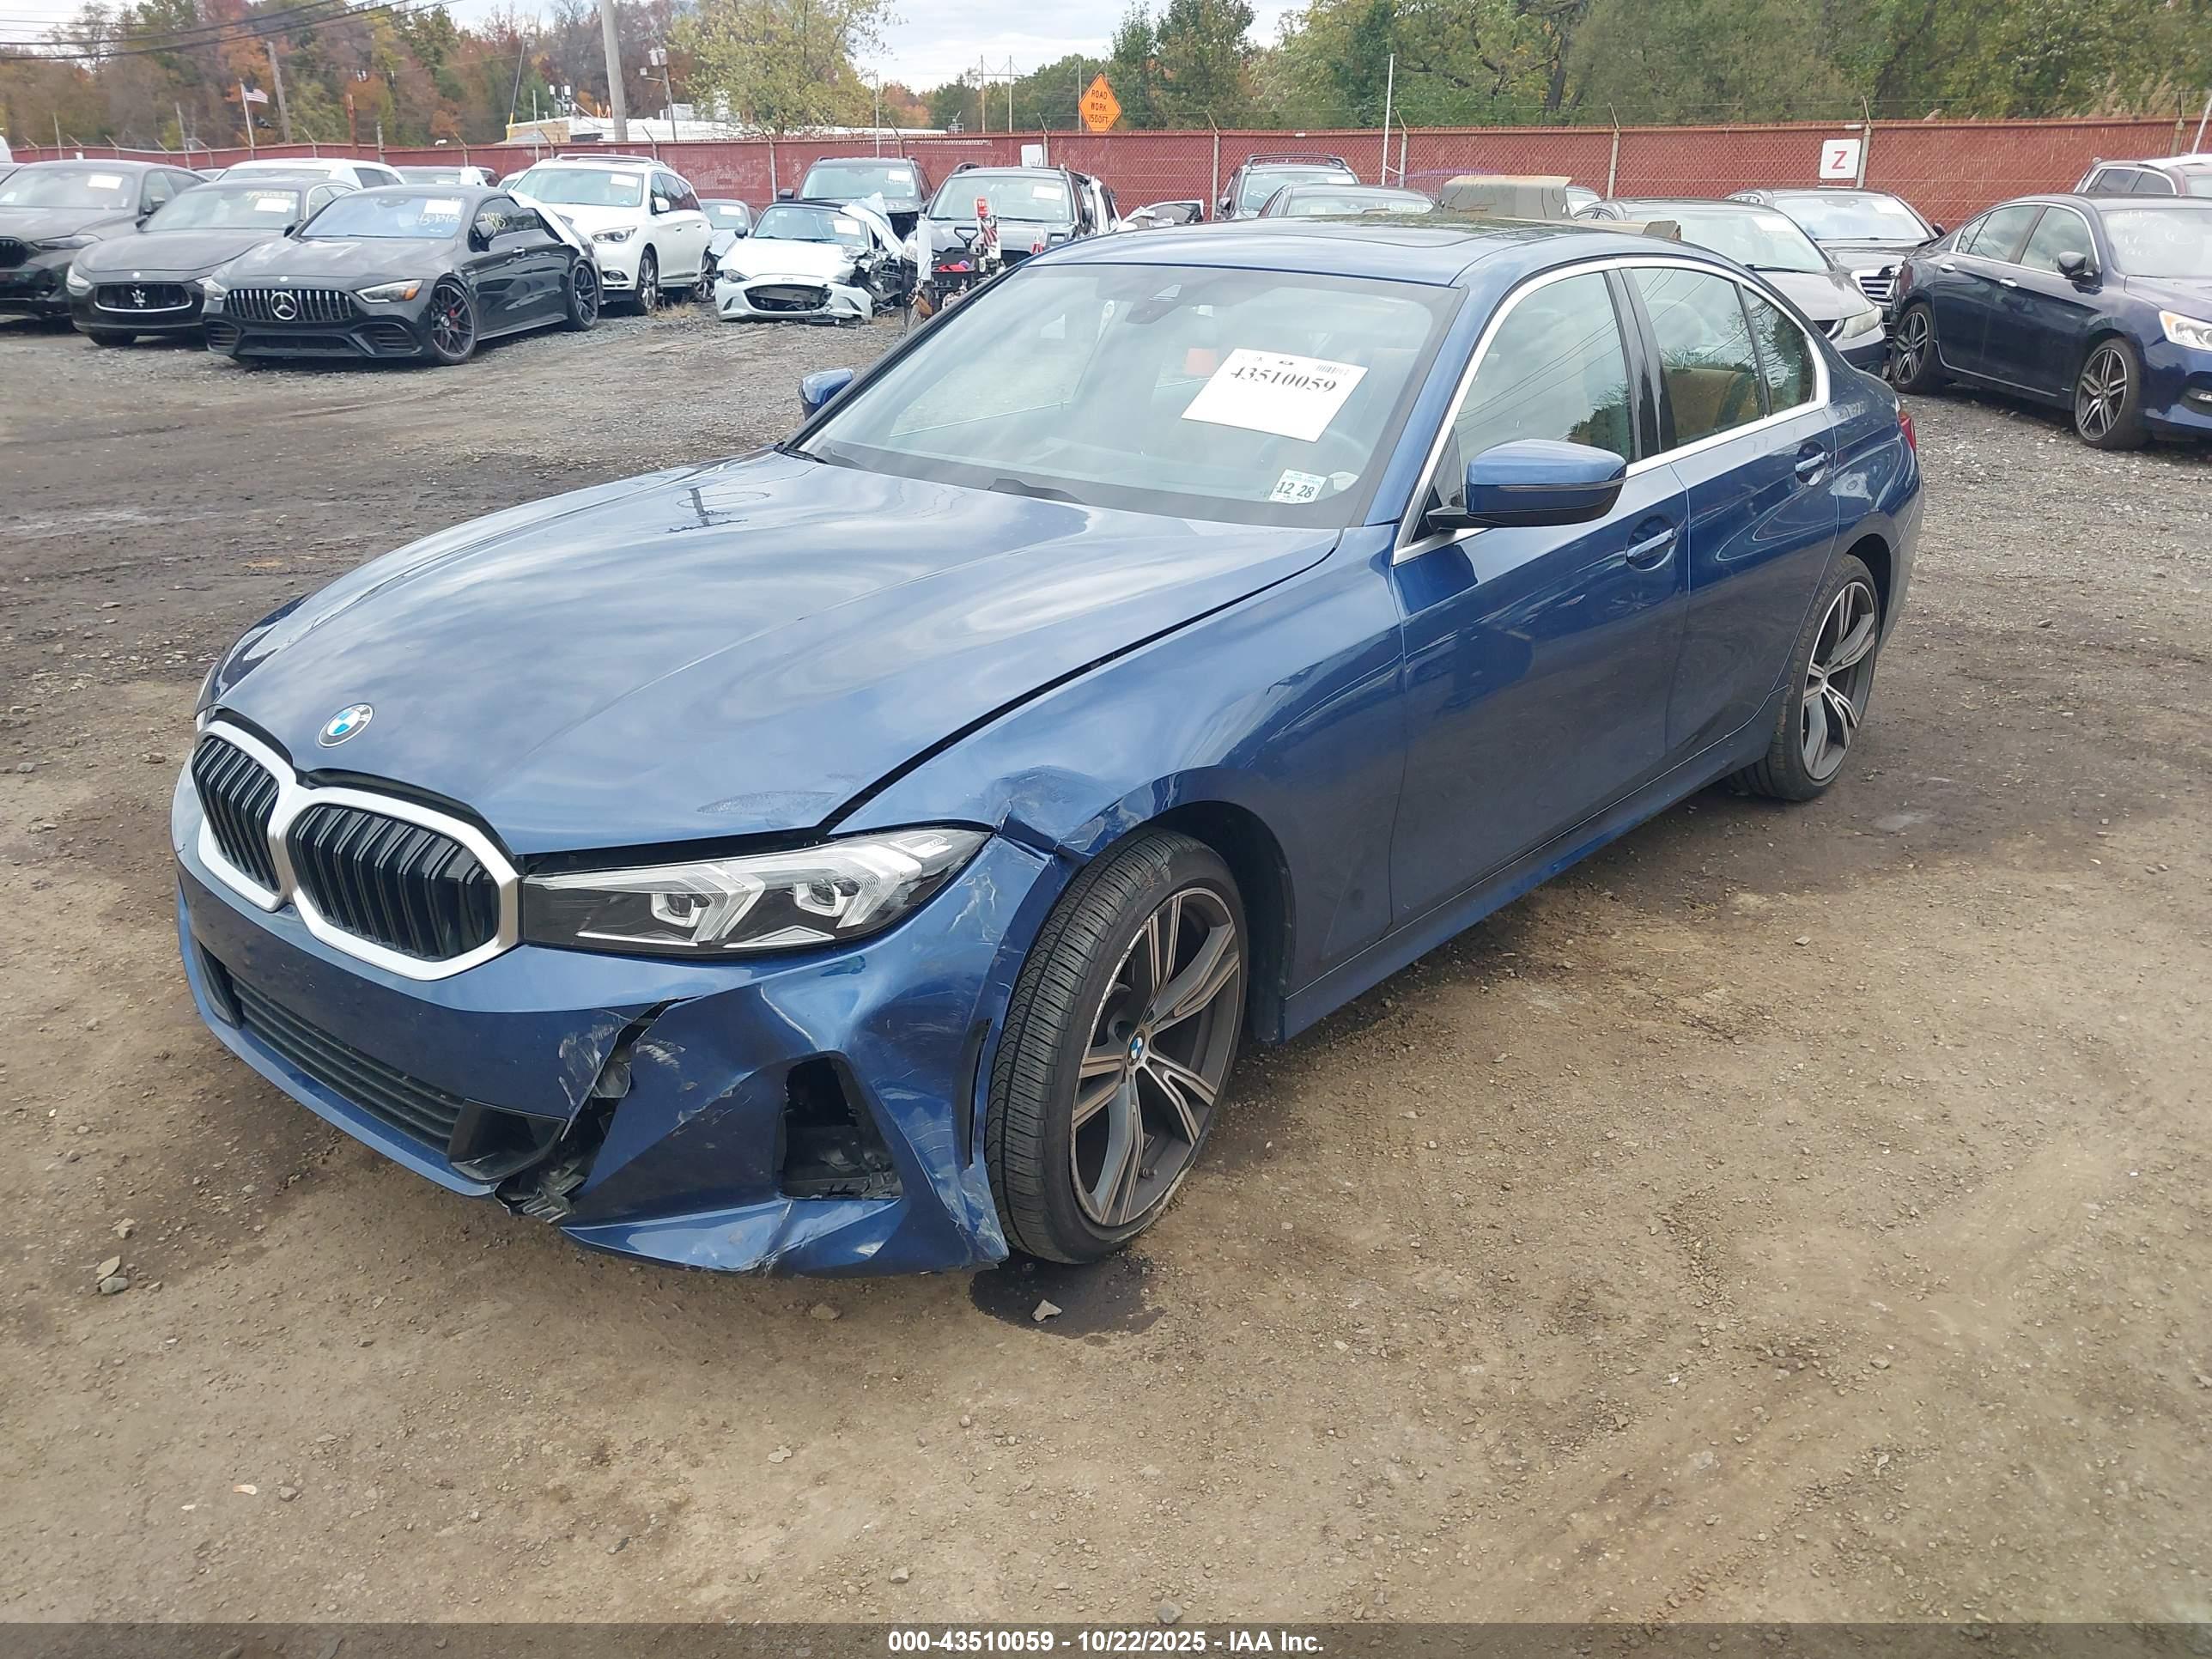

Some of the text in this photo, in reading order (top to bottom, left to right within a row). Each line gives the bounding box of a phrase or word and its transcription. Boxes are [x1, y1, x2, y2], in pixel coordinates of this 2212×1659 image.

[1091, 89, 1108, 100] ROAD
[1091, 102, 1107, 112] WORK
[1832, 150, 1847, 169] Z
[1231, 367, 1337, 392] 43510059
[1277, 481, 1295, 495] 12
[1297, 485, 1315, 498] 28
